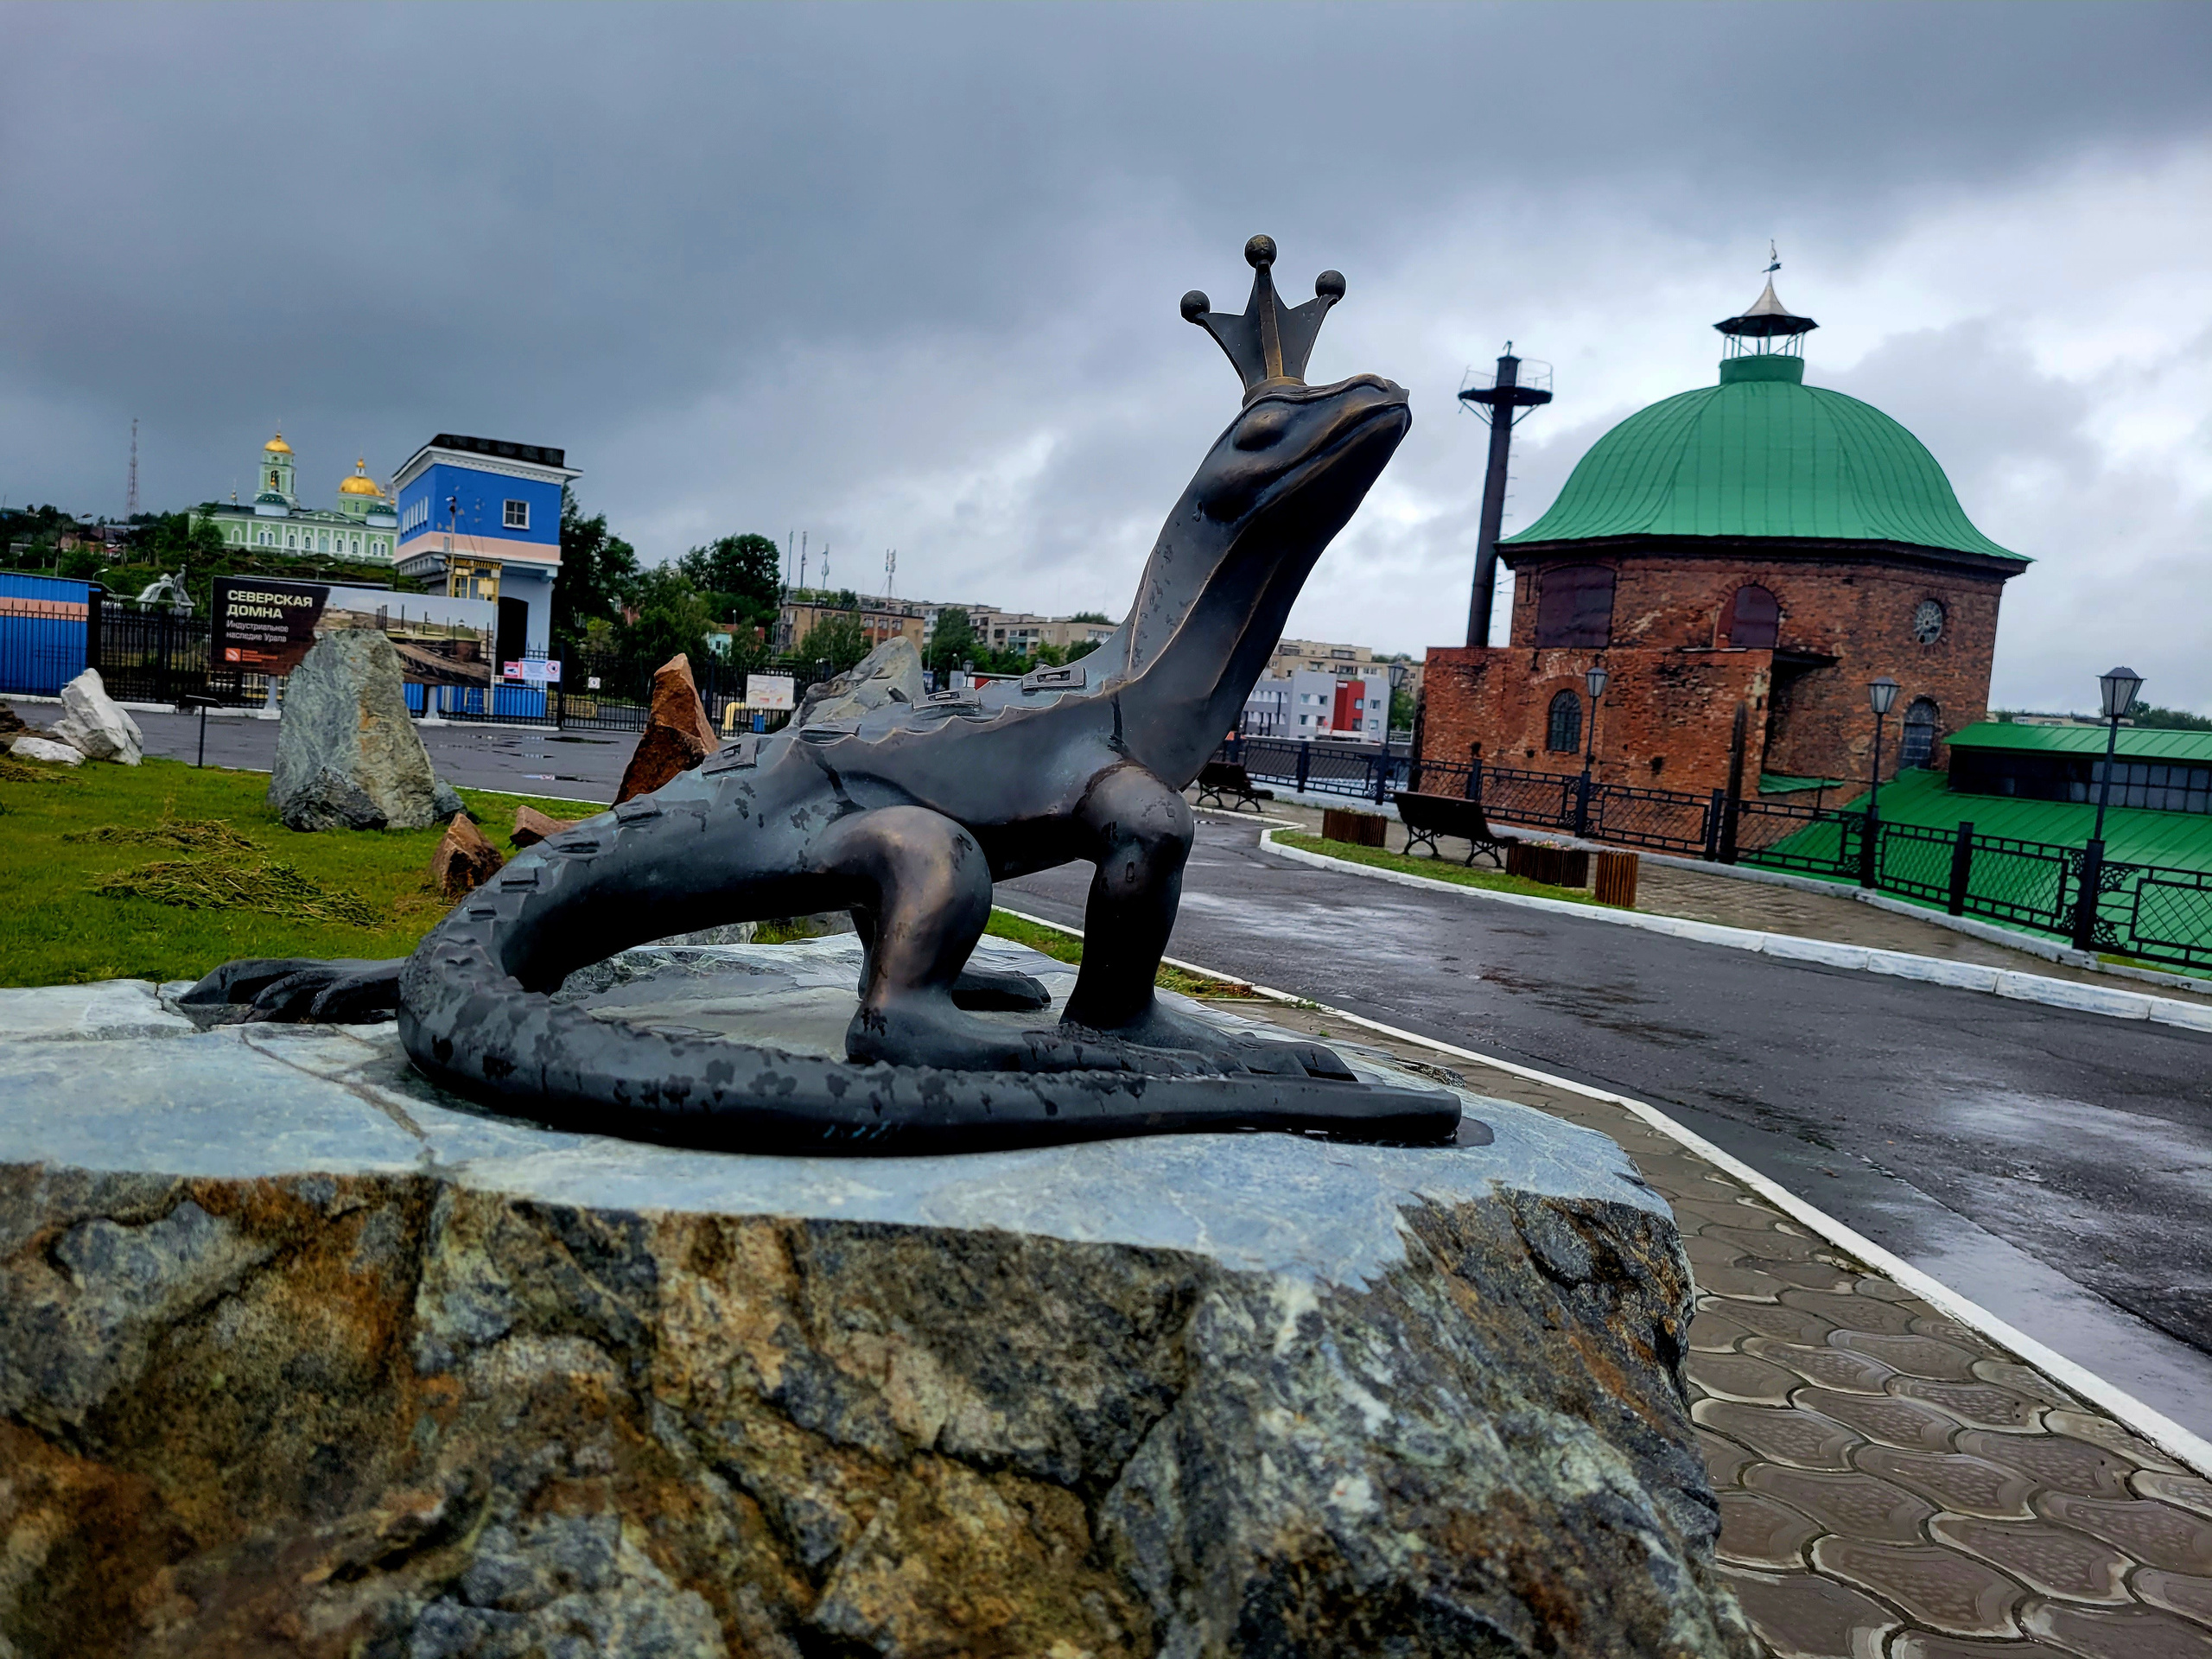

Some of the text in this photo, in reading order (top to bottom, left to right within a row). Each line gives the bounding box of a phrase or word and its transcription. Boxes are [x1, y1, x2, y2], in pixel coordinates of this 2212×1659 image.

[227, 589, 313, 607] СЕВЕРСКАЯ
[226, 603, 283, 619] ДОМНА
[226, 620, 289, 632] Индустриальное
[226, 632, 287, 643] наследие Урала
